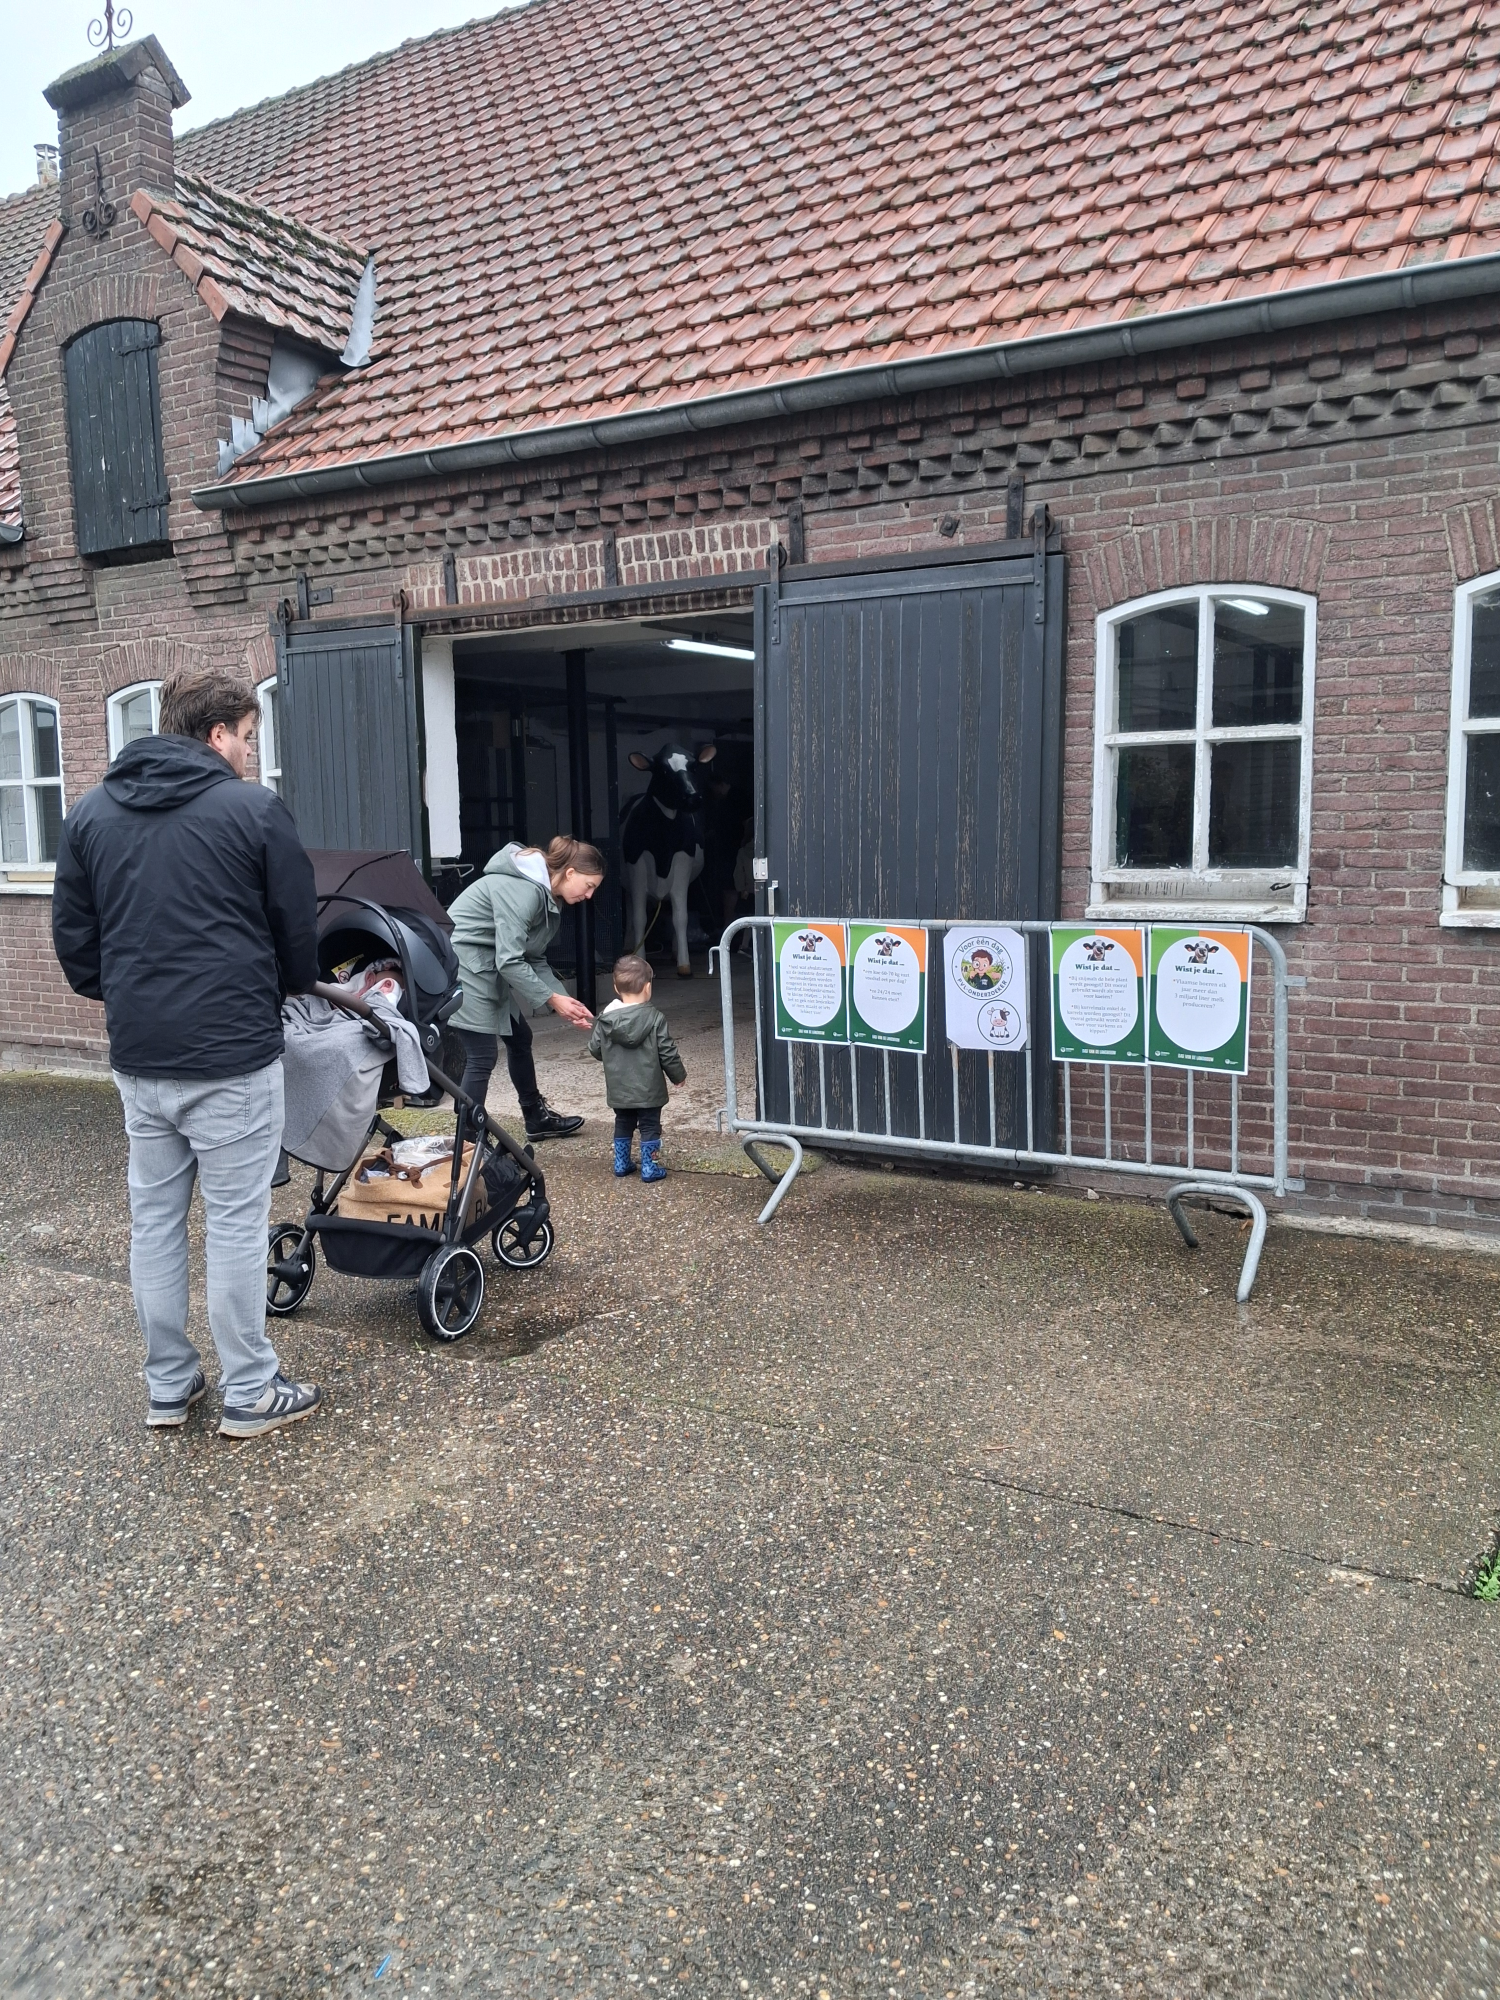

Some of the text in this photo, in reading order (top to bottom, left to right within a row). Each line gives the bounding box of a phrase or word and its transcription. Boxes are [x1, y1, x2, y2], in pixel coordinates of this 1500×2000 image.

[958, 940, 975, 953] Voor
[991, 943, 1004, 955] dag
[1193, 966, 1201, 974] je
